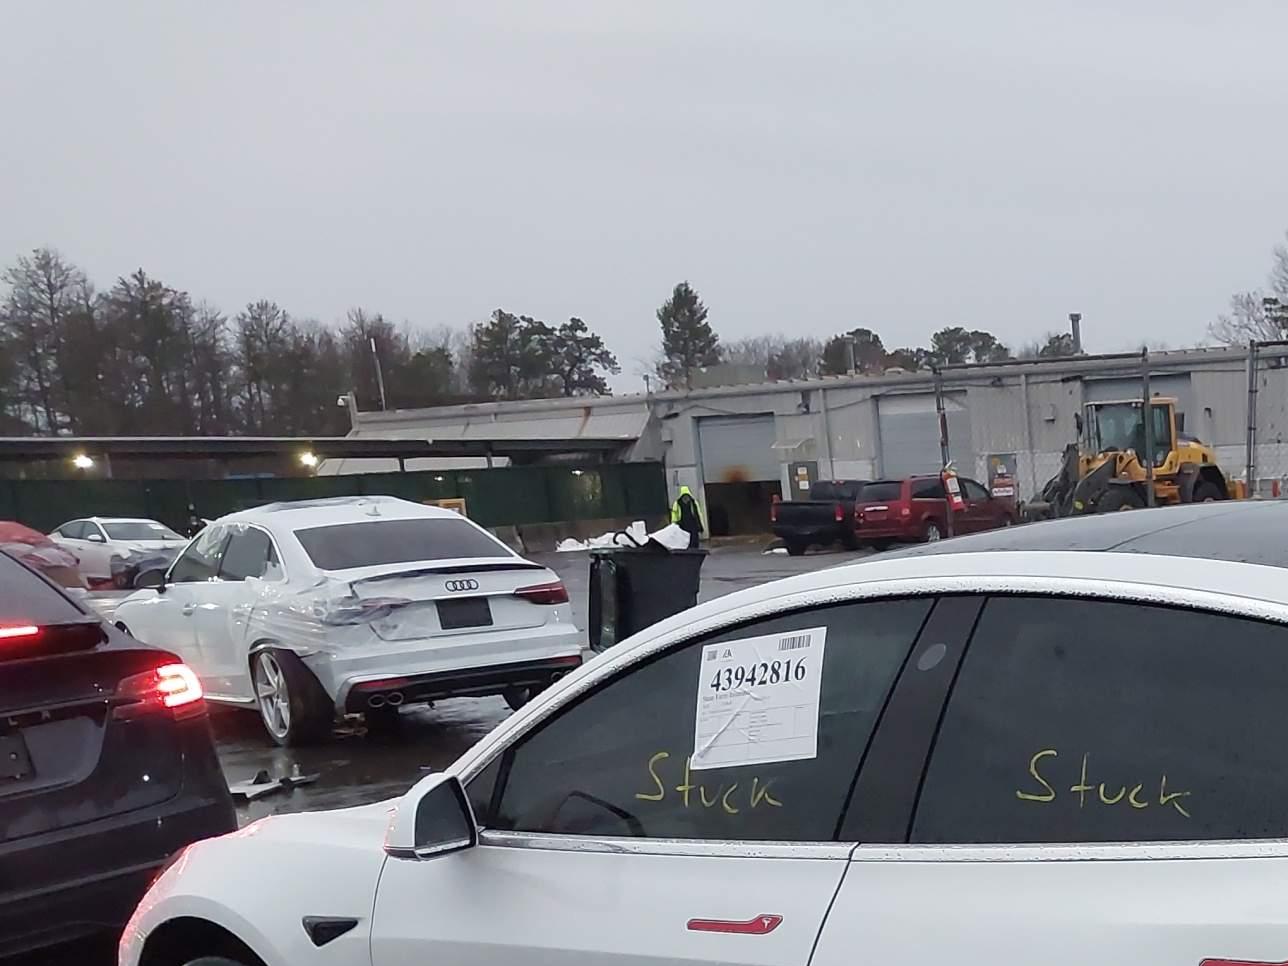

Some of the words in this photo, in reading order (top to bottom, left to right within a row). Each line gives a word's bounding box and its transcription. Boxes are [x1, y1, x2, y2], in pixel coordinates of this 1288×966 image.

[710, 656, 807, 692] 43942816
[635, 752, 782, 813] Stuck
[1016, 750, 1191, 818] Stuck
